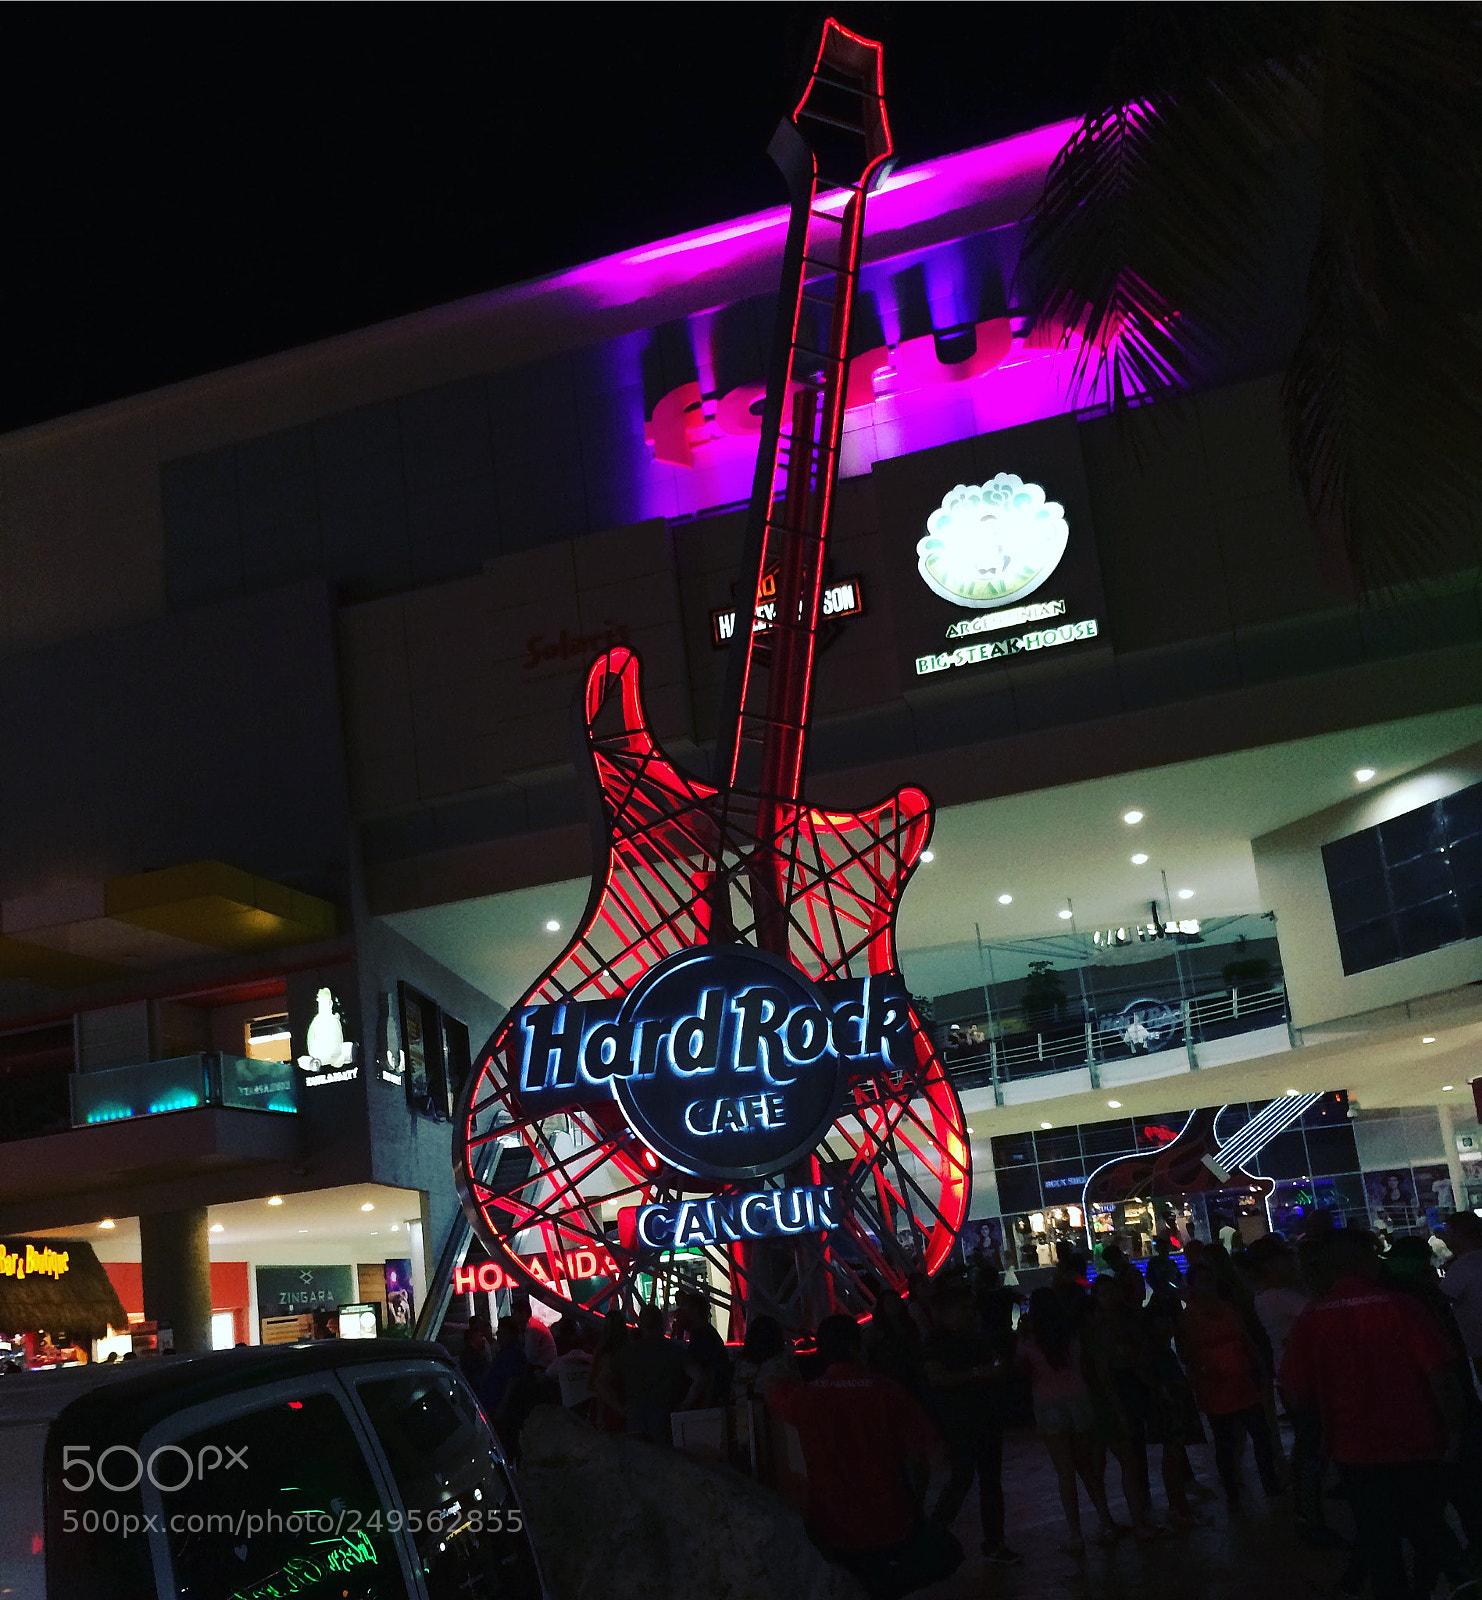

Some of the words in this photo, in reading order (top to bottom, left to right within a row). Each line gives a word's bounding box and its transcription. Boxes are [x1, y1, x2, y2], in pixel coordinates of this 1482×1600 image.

[945, 600, 1066, 638] ARGENIAN
[916, 654, 950, 675] BIG
[953, 637, 1022, 667] STEAK
[1022, 619, 1099, 650] HOUSE
[519, 987, 728, 1093] Hard
[729, 976, 912, 1086] Rock
[684, 1092, 788, 1136] CAFE
[637, 1186, 840, 1249] CANCUN
[25, 1244, 69, 1280] Boutique
[279, 1290, 335, 1305] ZINGARA
